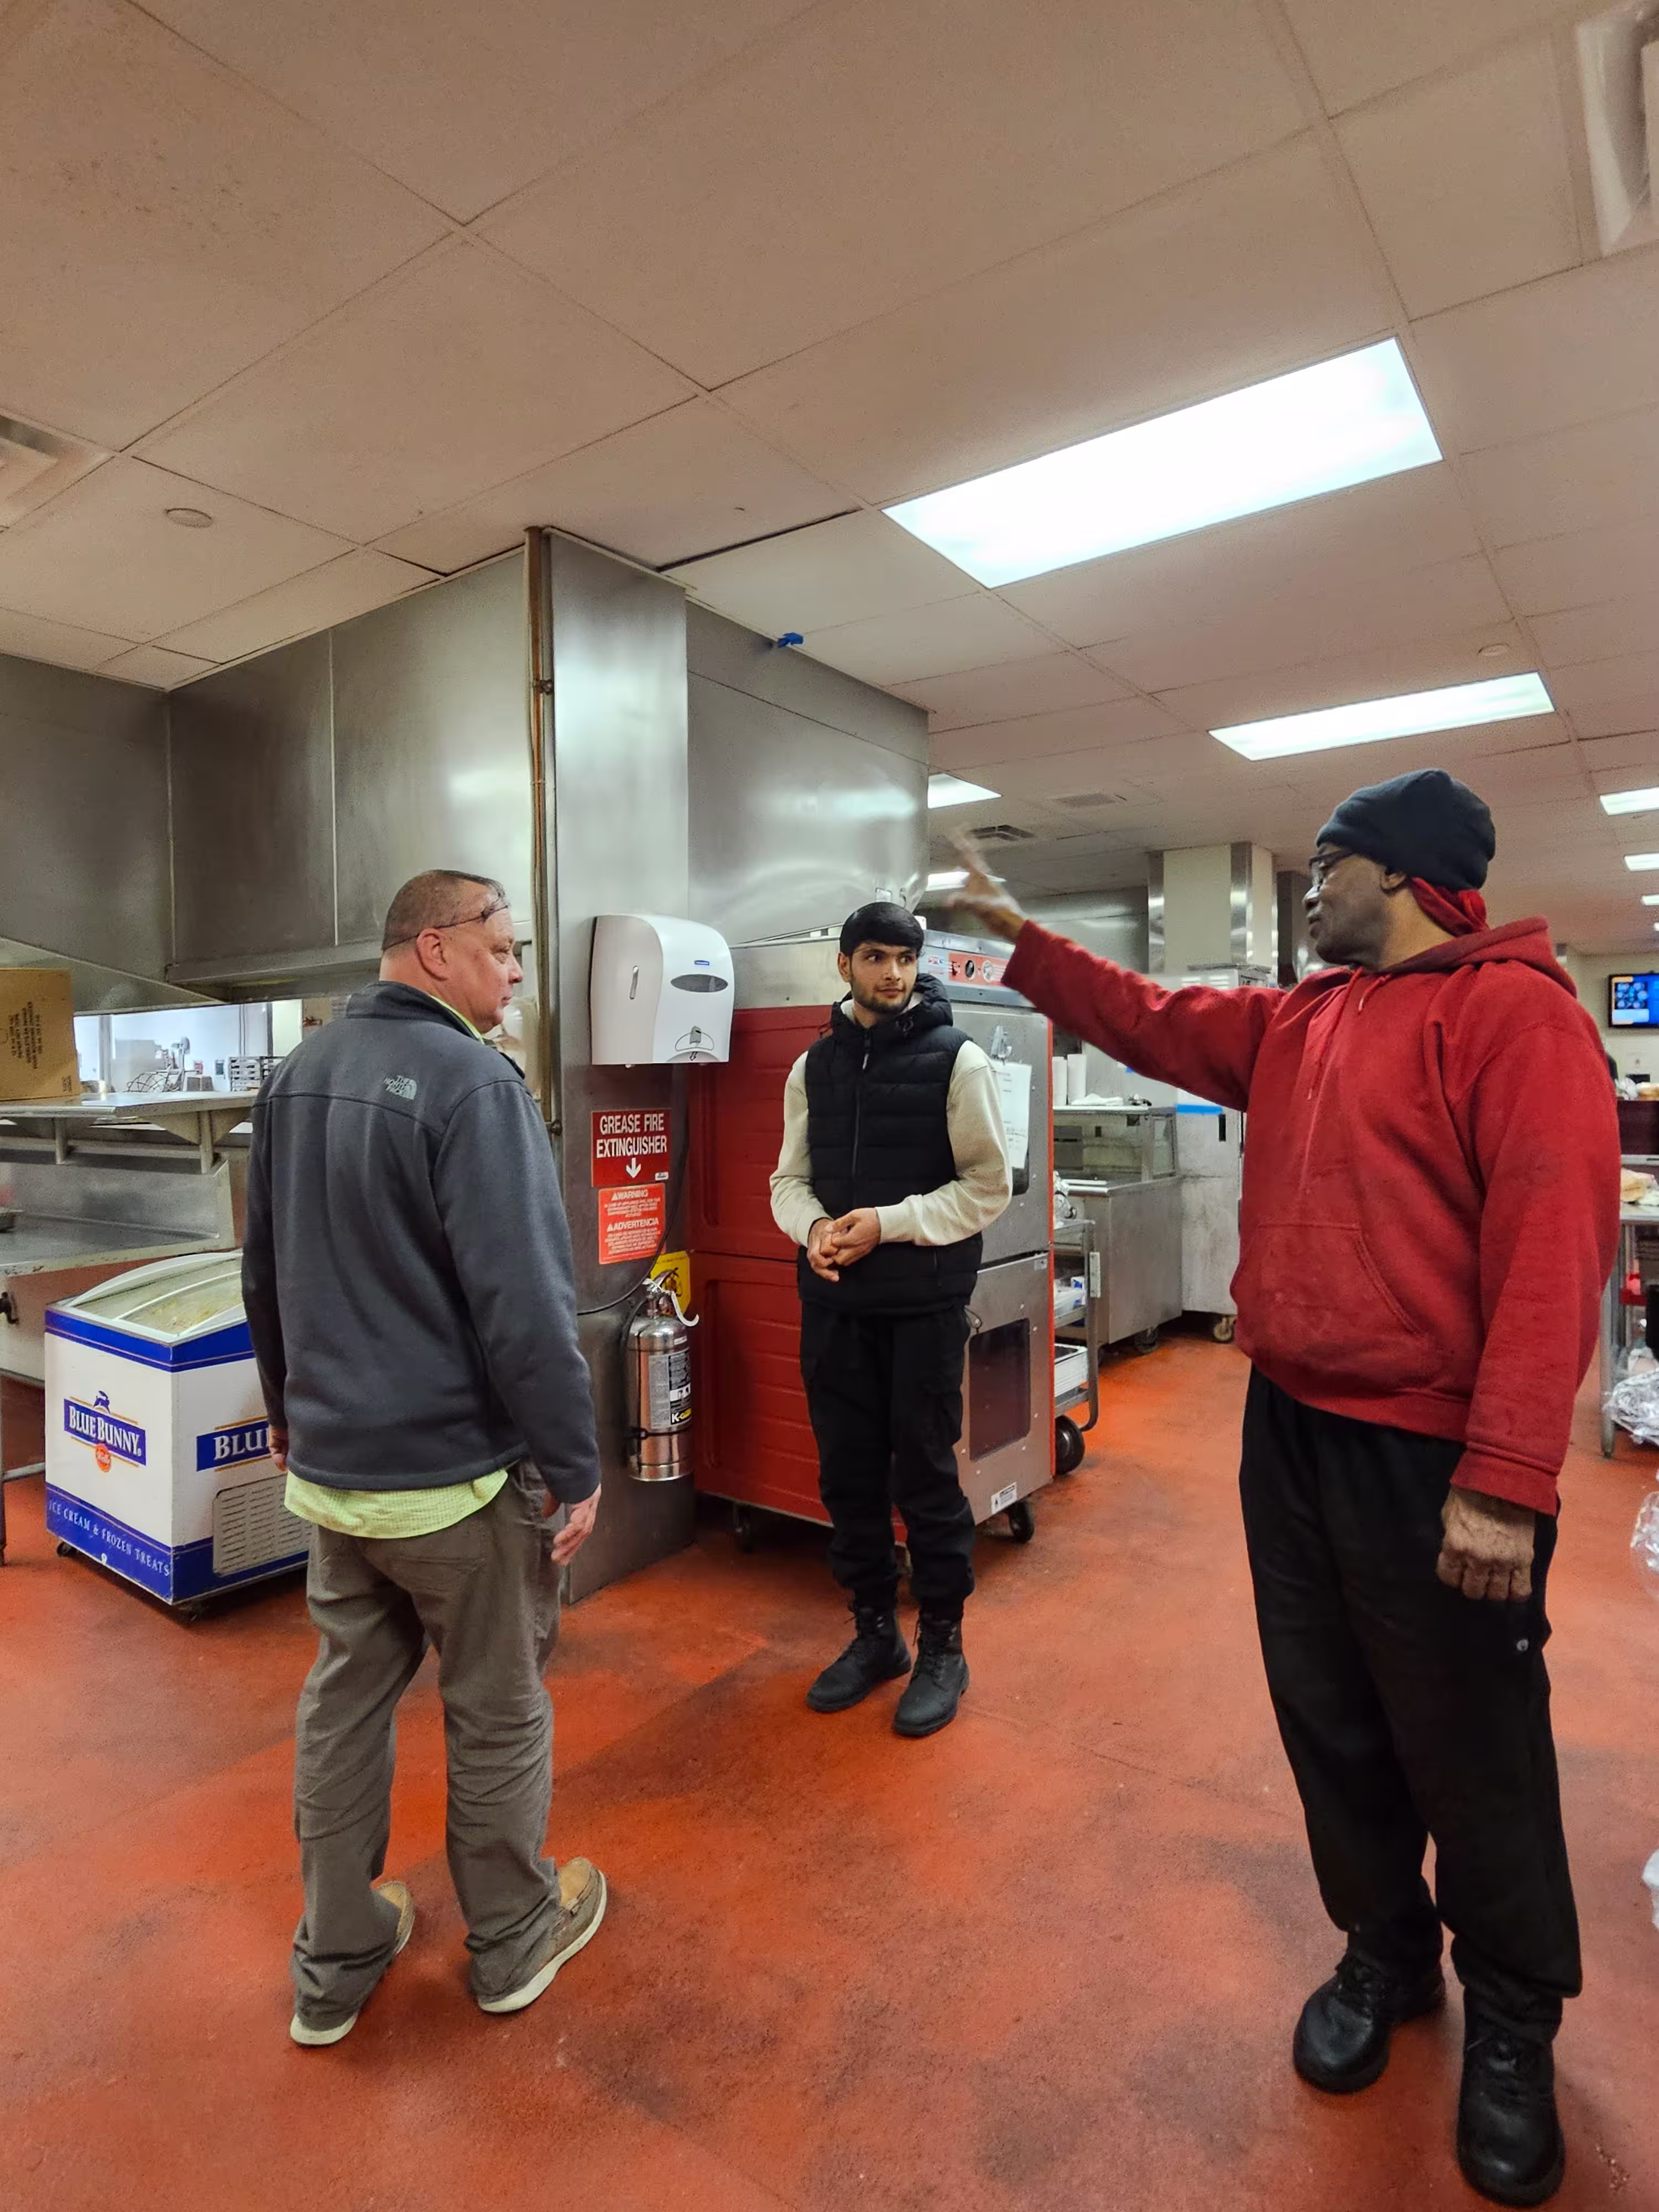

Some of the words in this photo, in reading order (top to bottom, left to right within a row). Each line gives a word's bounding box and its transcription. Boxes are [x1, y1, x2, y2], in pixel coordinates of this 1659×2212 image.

[599, 1114, 641, 1135] GREASE
[644, 1113, 665, 1132] FIRE
[596, 1135, 667, 1159] EXTINGUISHER
[617, 1190, 649, 1199] WARNING
[614, 1217, 660, 1230] ADVERTENCIA
[69, 1405, 96, 1438] BLUE
[97, 1416, 139, 1455] BUNNY
[49, 1500, 61, 1515] ICE
[63, 1508, 91, 1531] CREAM
[93, 1524, 99, 1536] &
[102, 1528, 132, 1556] FROZEN
[134, 1548, 170, 1577] TREATS
